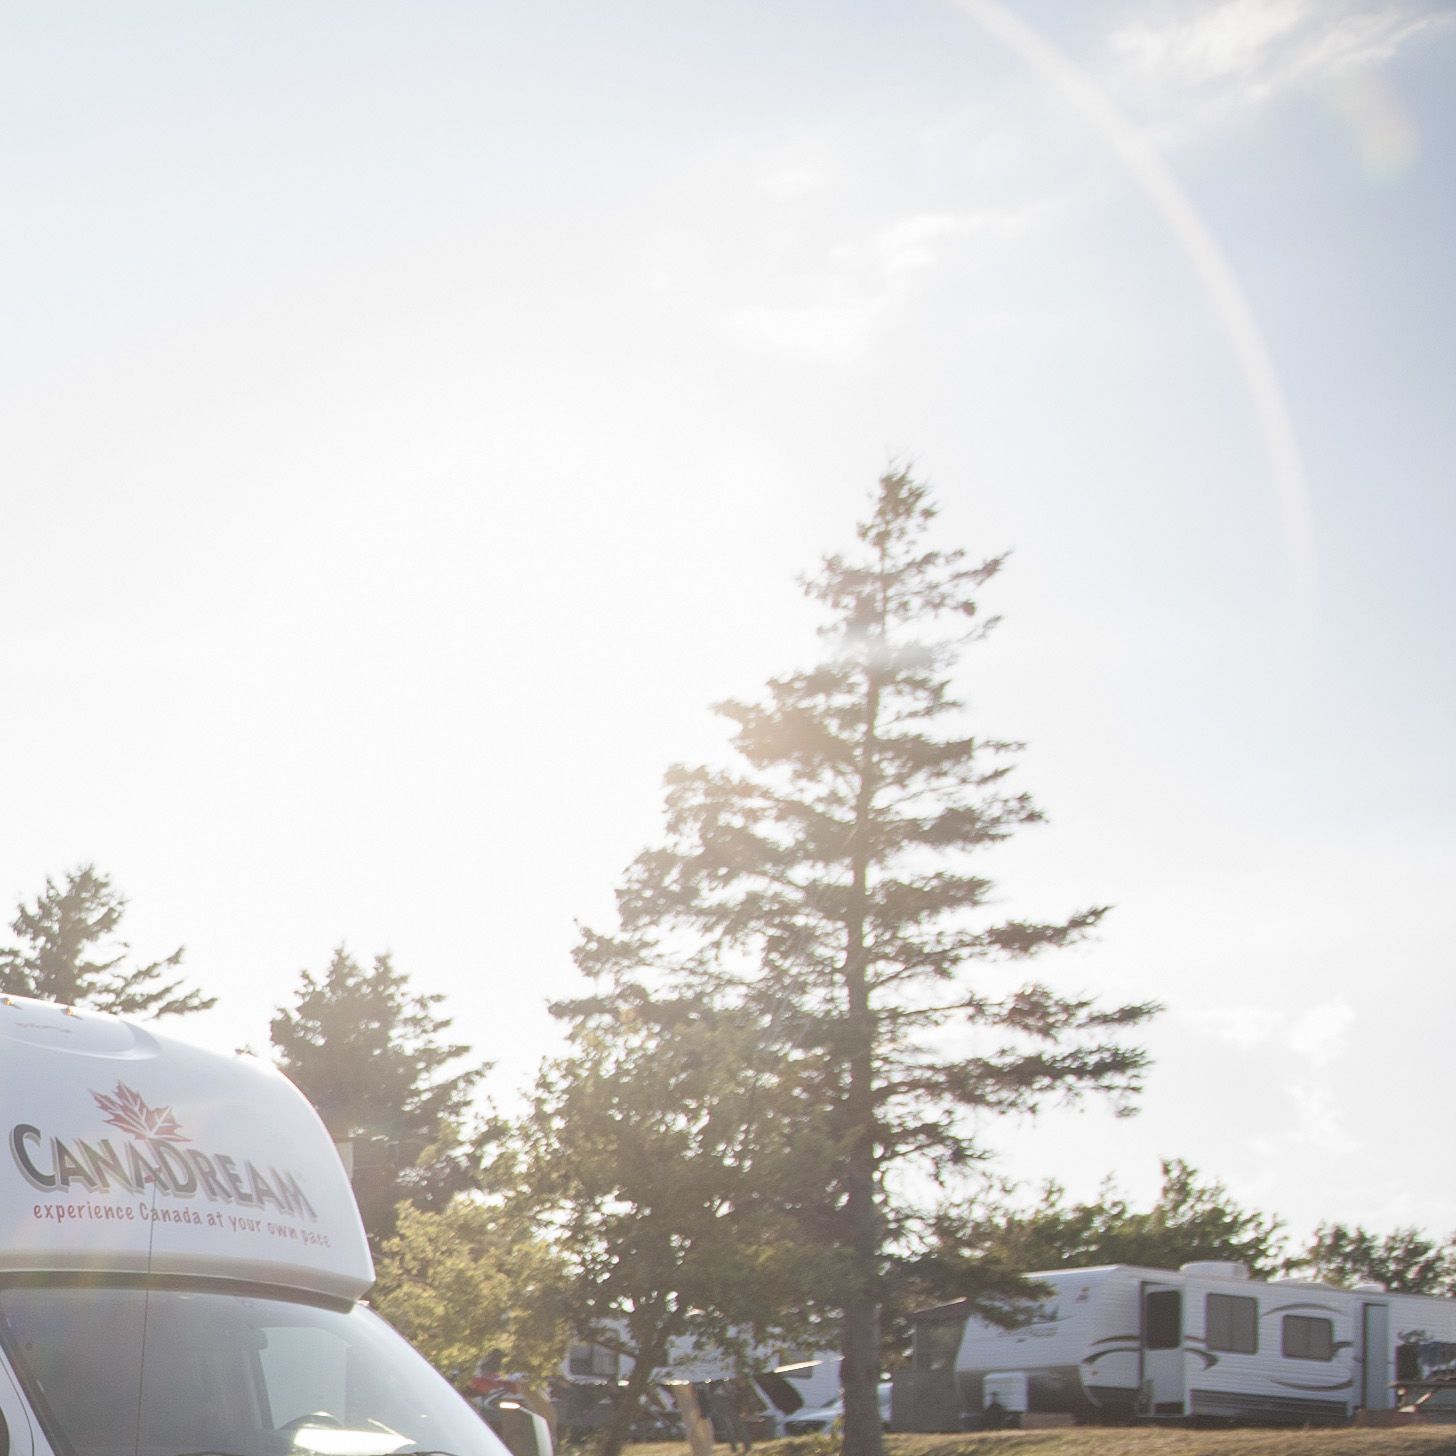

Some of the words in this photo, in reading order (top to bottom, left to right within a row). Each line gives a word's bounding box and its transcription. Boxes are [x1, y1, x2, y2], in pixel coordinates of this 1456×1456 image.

[33, 1201, 135, 1223] experience
[139, 1202, 202, 1225] Canada
[207, 1211, 224, 1227] at
[228, 1215, 261, 1232] your
[268, 1222, 297, 1239] own
[300, 1229, 331, 1248] pace
